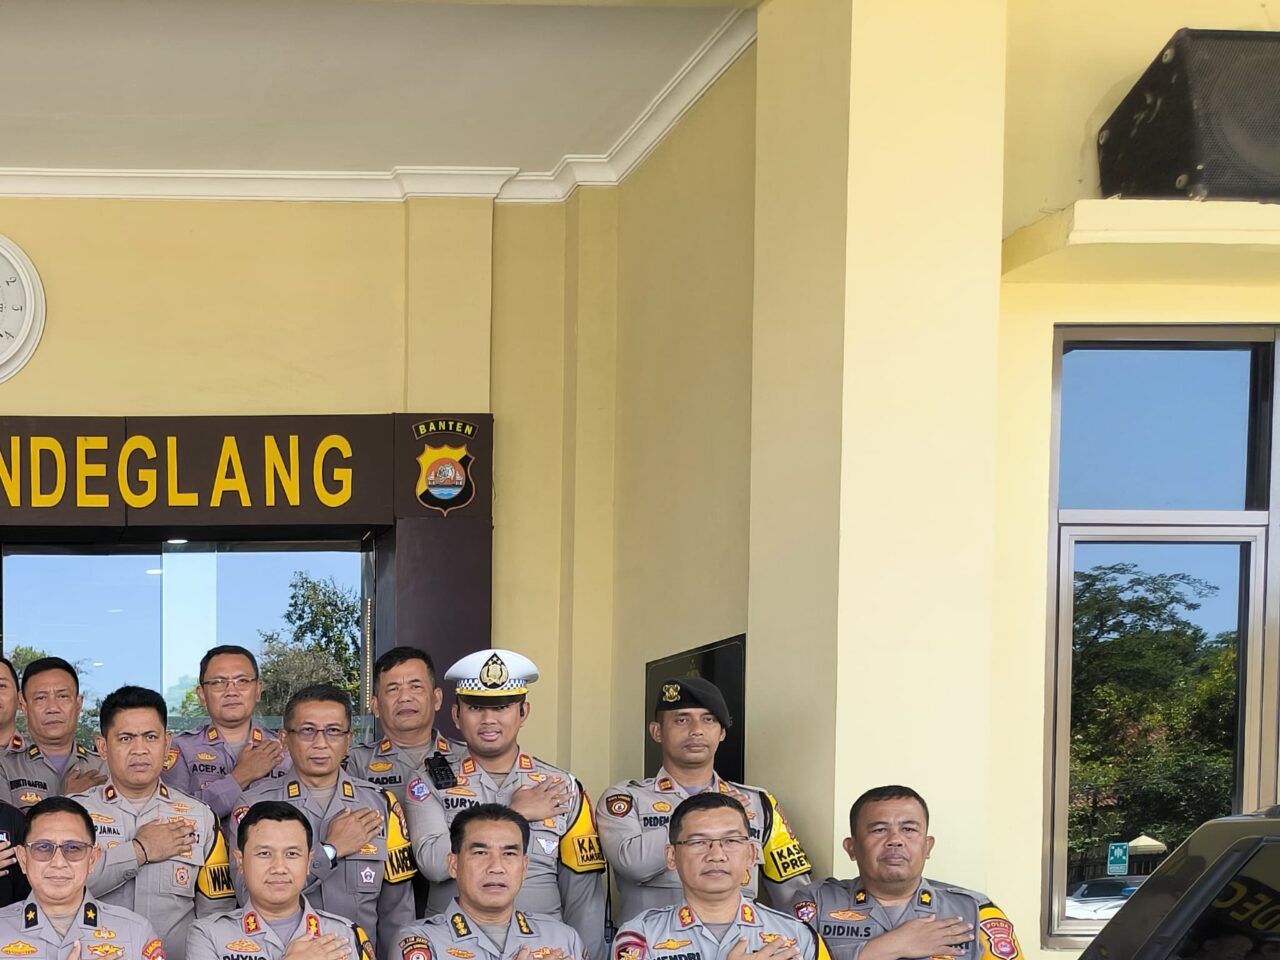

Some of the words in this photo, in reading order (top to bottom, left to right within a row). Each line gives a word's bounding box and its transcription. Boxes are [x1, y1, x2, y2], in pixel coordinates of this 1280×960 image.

[5, 276, 17, 286] 2
[418, 420, 474, 435] BANTEN
[191, 763, 227, 775] ACEP.K
[368, 775, 402, 785] SADELI
[444, 797, 481, 810] SURYA
[99, 825, 121, 836] JAMAL
[823, 924, 871, 938] DIDIN.S
